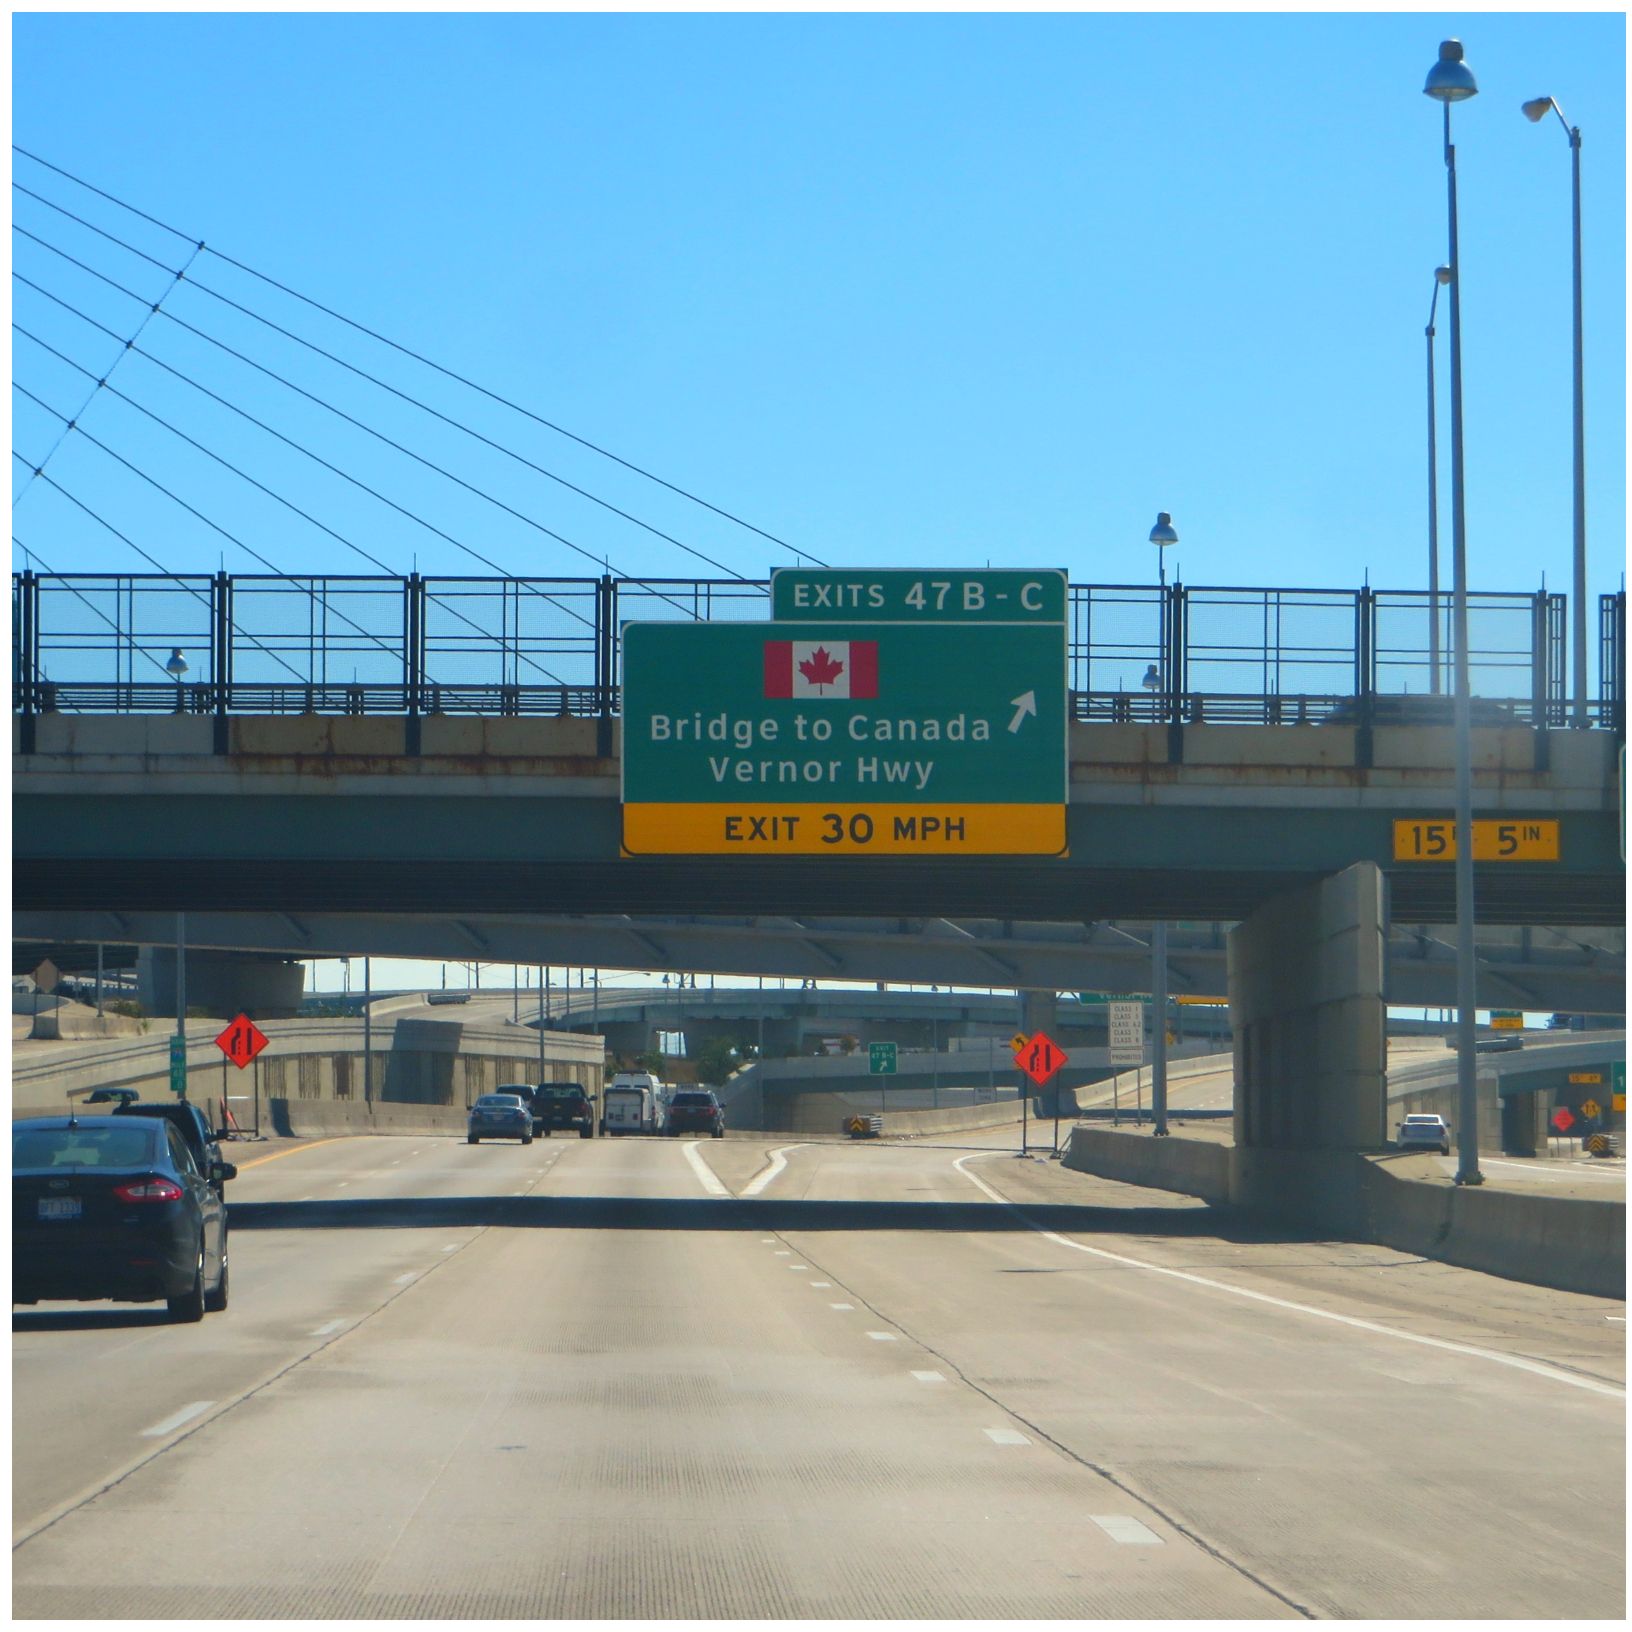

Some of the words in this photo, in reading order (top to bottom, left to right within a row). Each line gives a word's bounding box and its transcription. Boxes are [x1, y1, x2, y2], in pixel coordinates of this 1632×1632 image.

[794, 584, 885, 608] EXITS
[905, 582, 951, 611] 47
[651, 714, 779, 748] Bridge
[795, 717, 832, 741] to
[849, 714, 990, 741] Canada
[709, 757, 841, 782] Vernor
[858, 757, 934, 790] Hwy
[725, 817, 800, 841] EXIT
[821, 813, 873, 843] 30
[893, 817, 966, 841] MPH
[1412, 826, 1446, 855] 15
[1498, 826, 1518, 855] 5
[1523, 826, 1540, 841] IN
